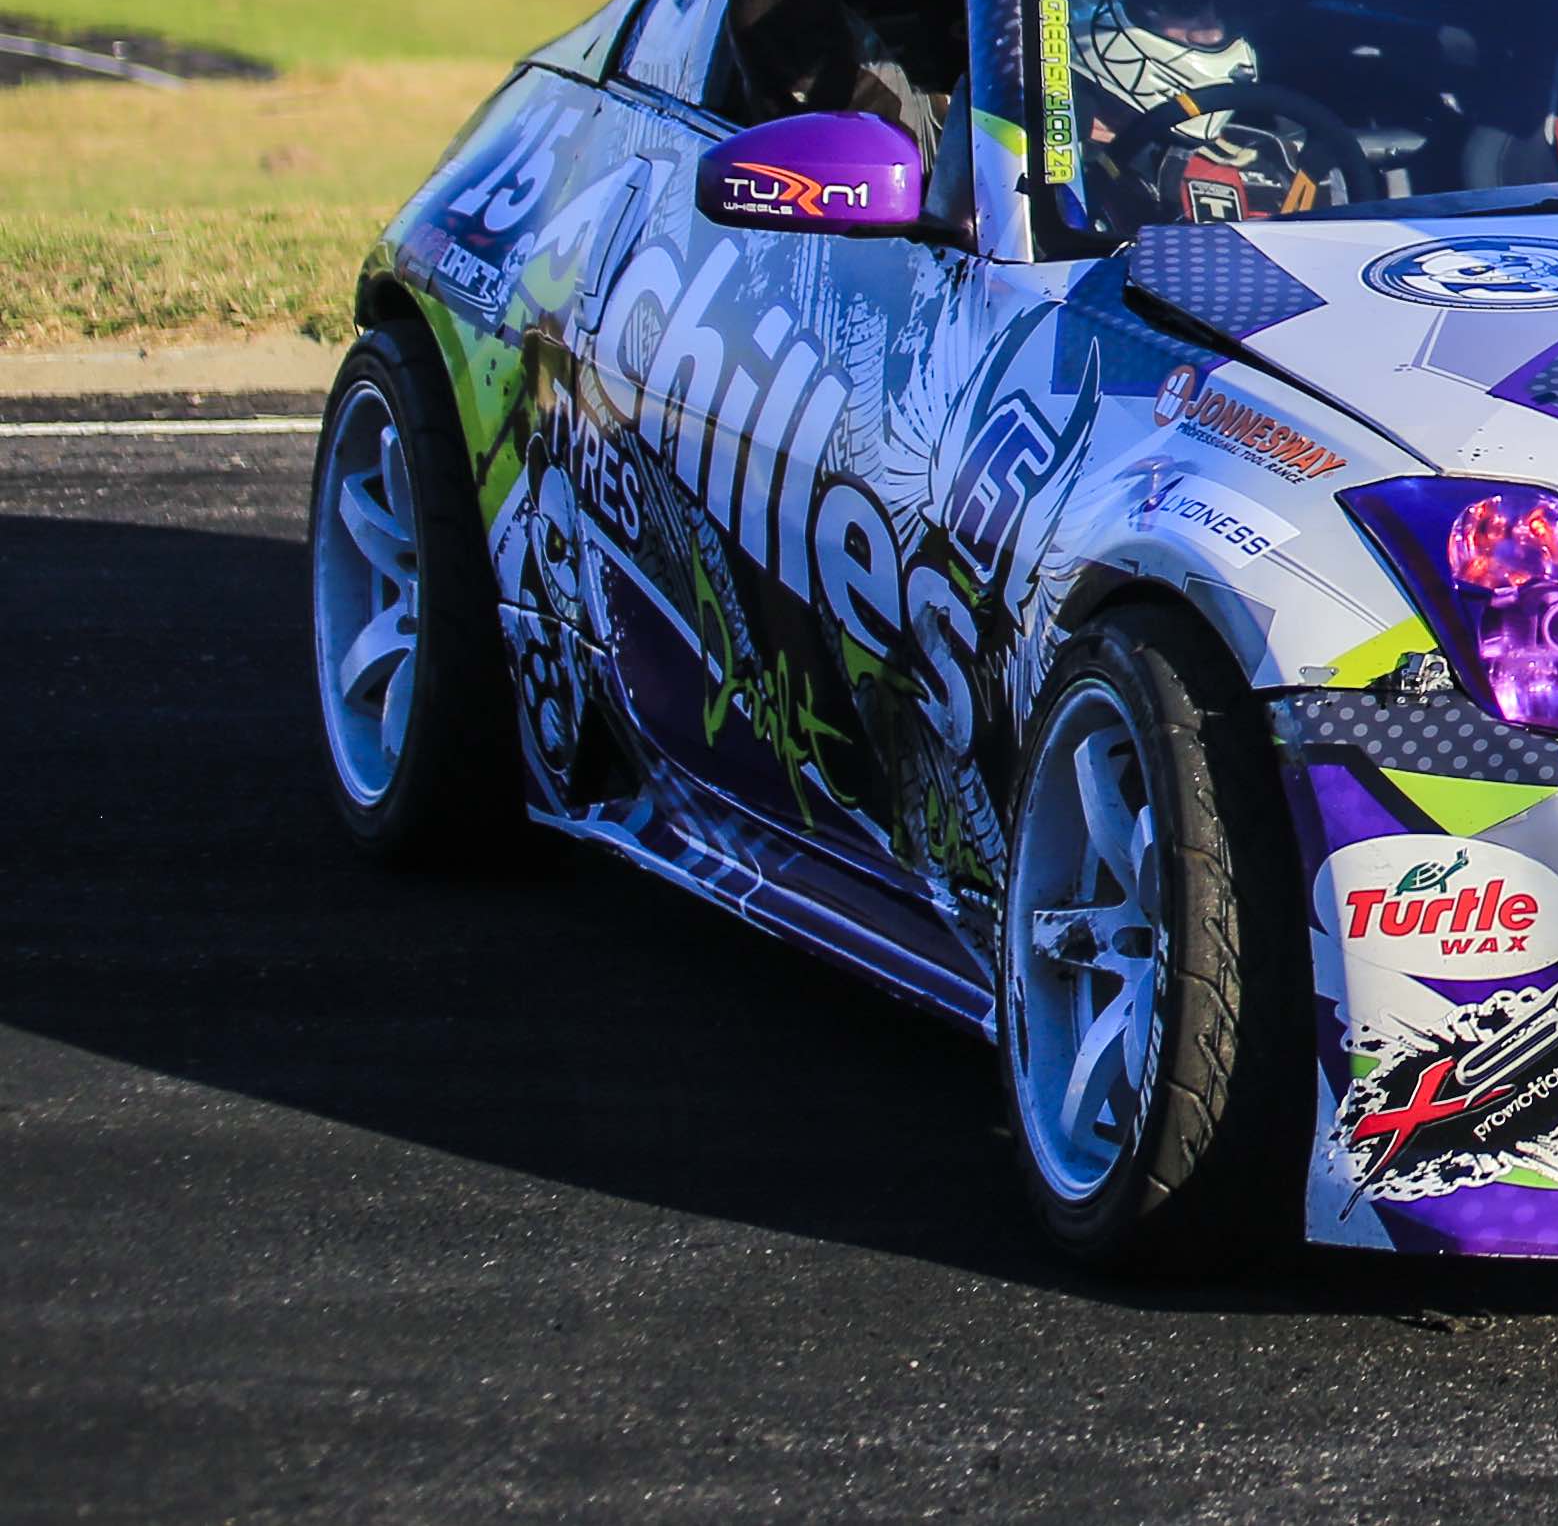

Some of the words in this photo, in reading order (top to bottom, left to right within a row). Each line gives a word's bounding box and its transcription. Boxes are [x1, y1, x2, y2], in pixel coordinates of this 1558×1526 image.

[448, 96, 585, 232] 15
[515, 154, 982, 759] Achilles
[553, 377, 642, 542] TYRES
[1184, 387, 1348, 480] JONNESWAY
[1265, 461, 1307, 486] RANGE
[1160, 494, 1271, 557] LYONESS
[1346, 878, 1539, 939] Turtle
[1440, 935, 1531, 956] WAX
